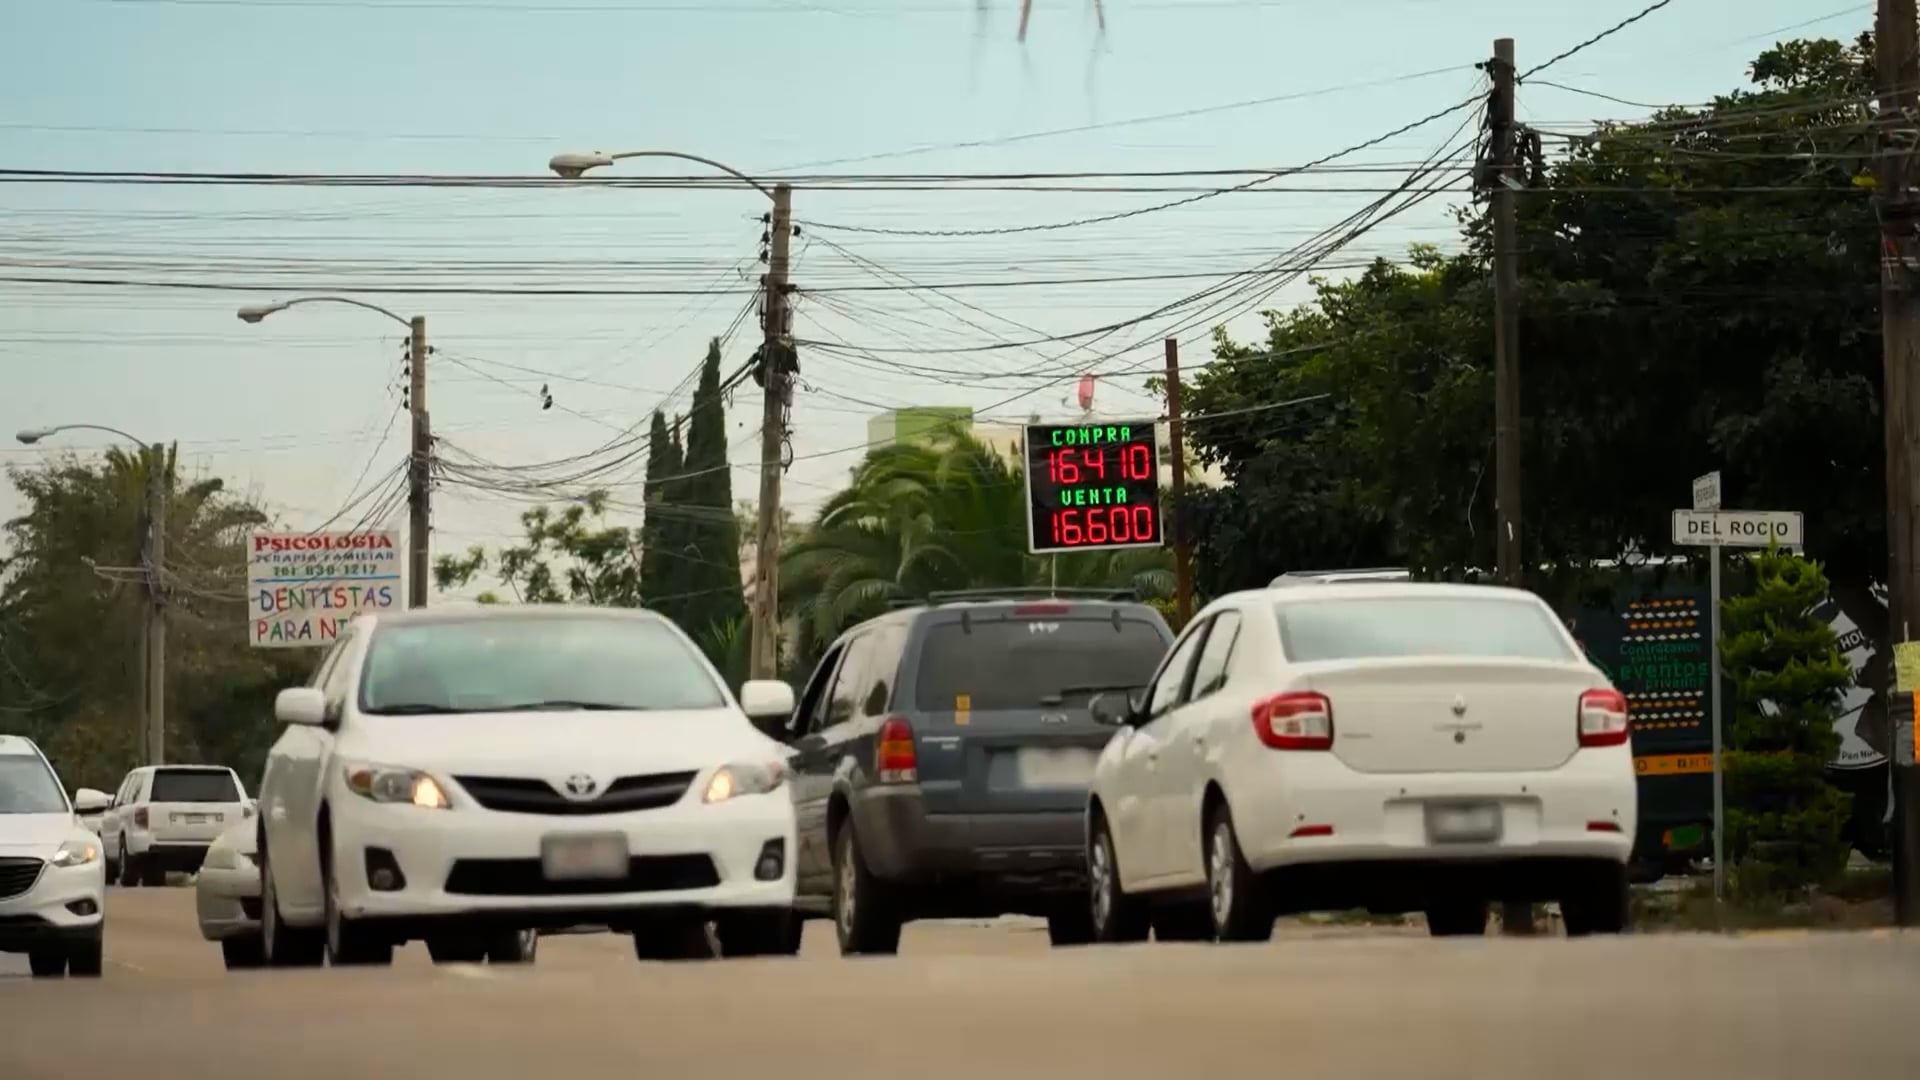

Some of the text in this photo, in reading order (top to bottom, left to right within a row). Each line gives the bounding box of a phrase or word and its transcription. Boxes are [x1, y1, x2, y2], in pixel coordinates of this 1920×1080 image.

[1052, 427, 1131, 446] COMPRA
[1061, 487, 1127, 506] VENTA
[1052, 506, 1153, 544] 16.600
[1688, 520, 1788, 536] DEL ROCIO
[255, 534, 392, 552] PSICOLOGIA
[324, 552, 394, 562] FAMILIAR
[260, 586, 393, 612] DENTISTAS
[257, 619, 312, 642] PARA
